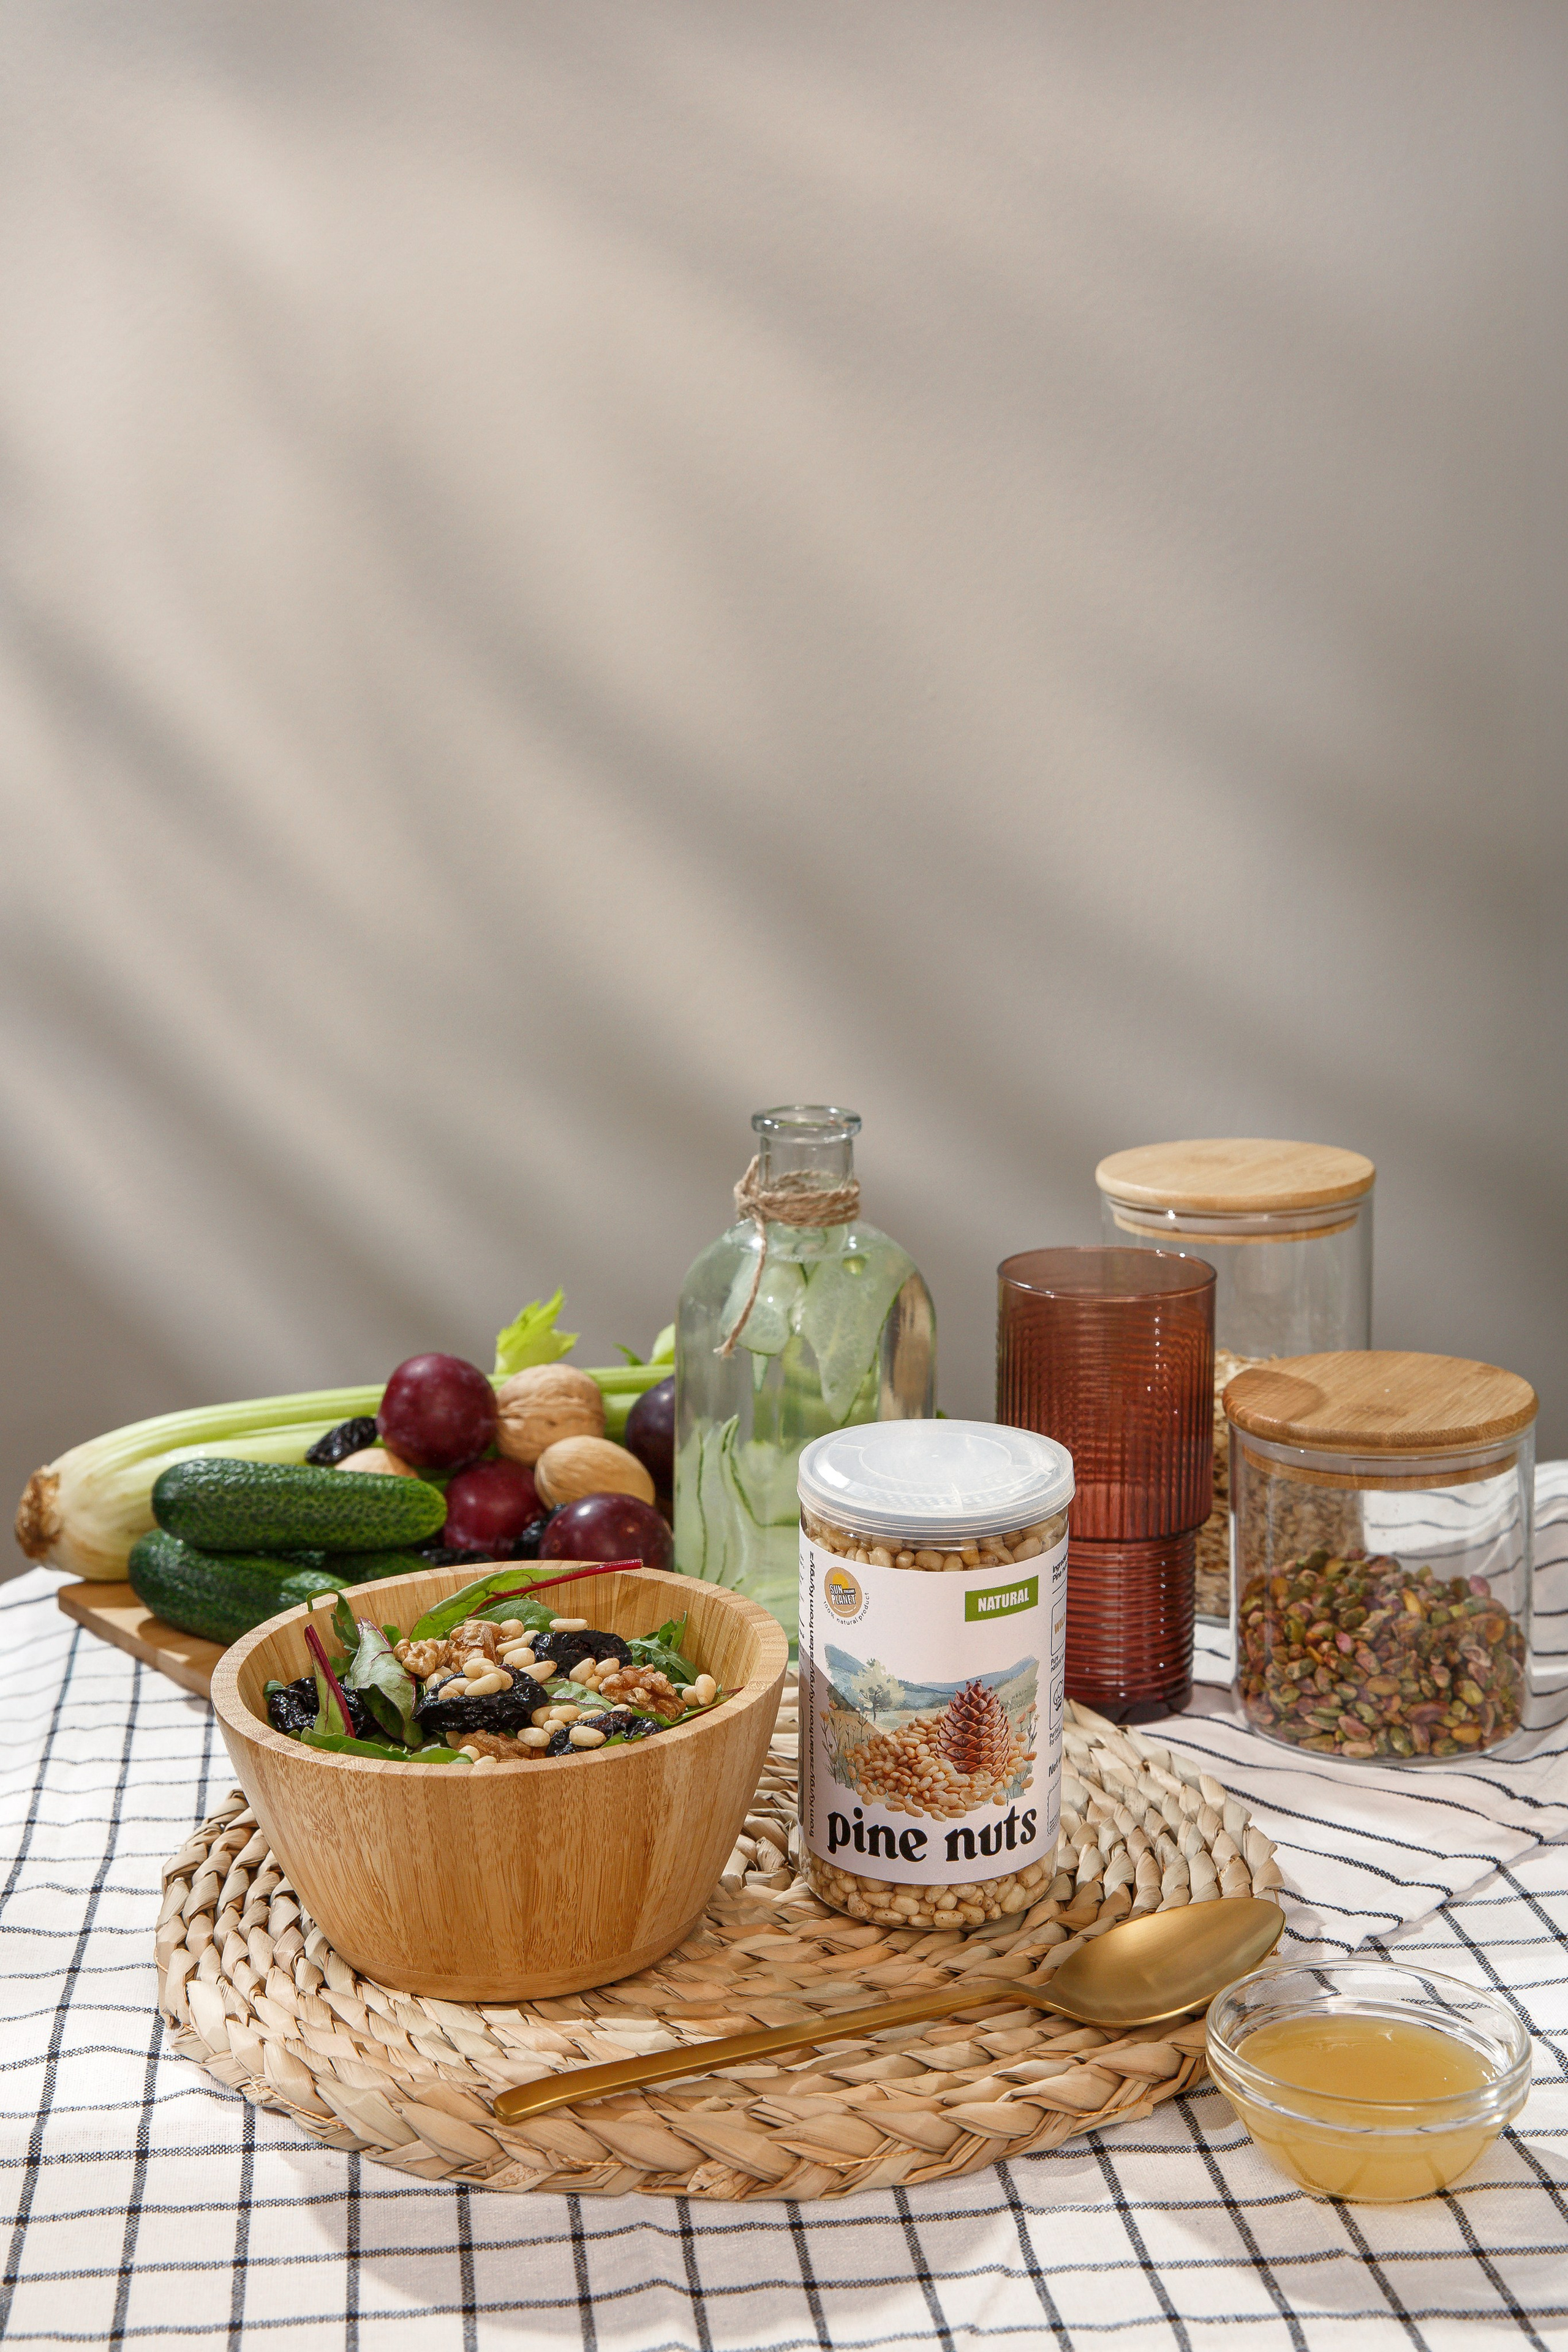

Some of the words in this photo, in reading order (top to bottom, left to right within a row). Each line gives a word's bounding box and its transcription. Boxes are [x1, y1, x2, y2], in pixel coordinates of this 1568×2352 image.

[1052, 1571, 1061, 1583] Pine
[829, 1584, 843, 1594] SUN
[831, 1594, 856, 1605] PLANET
[978, 1588, 1030, 1612] NATURAL
[823, 1600, 835, 1619] 100%
[837, 1617, 859, 1626] natural
[858, 1593, 870, 1621] product
[1049, 1758, 1058, 1777] Net
[827, 1807, 928, 1863] pine
[944, 1806, 1037, 1862] nuts
